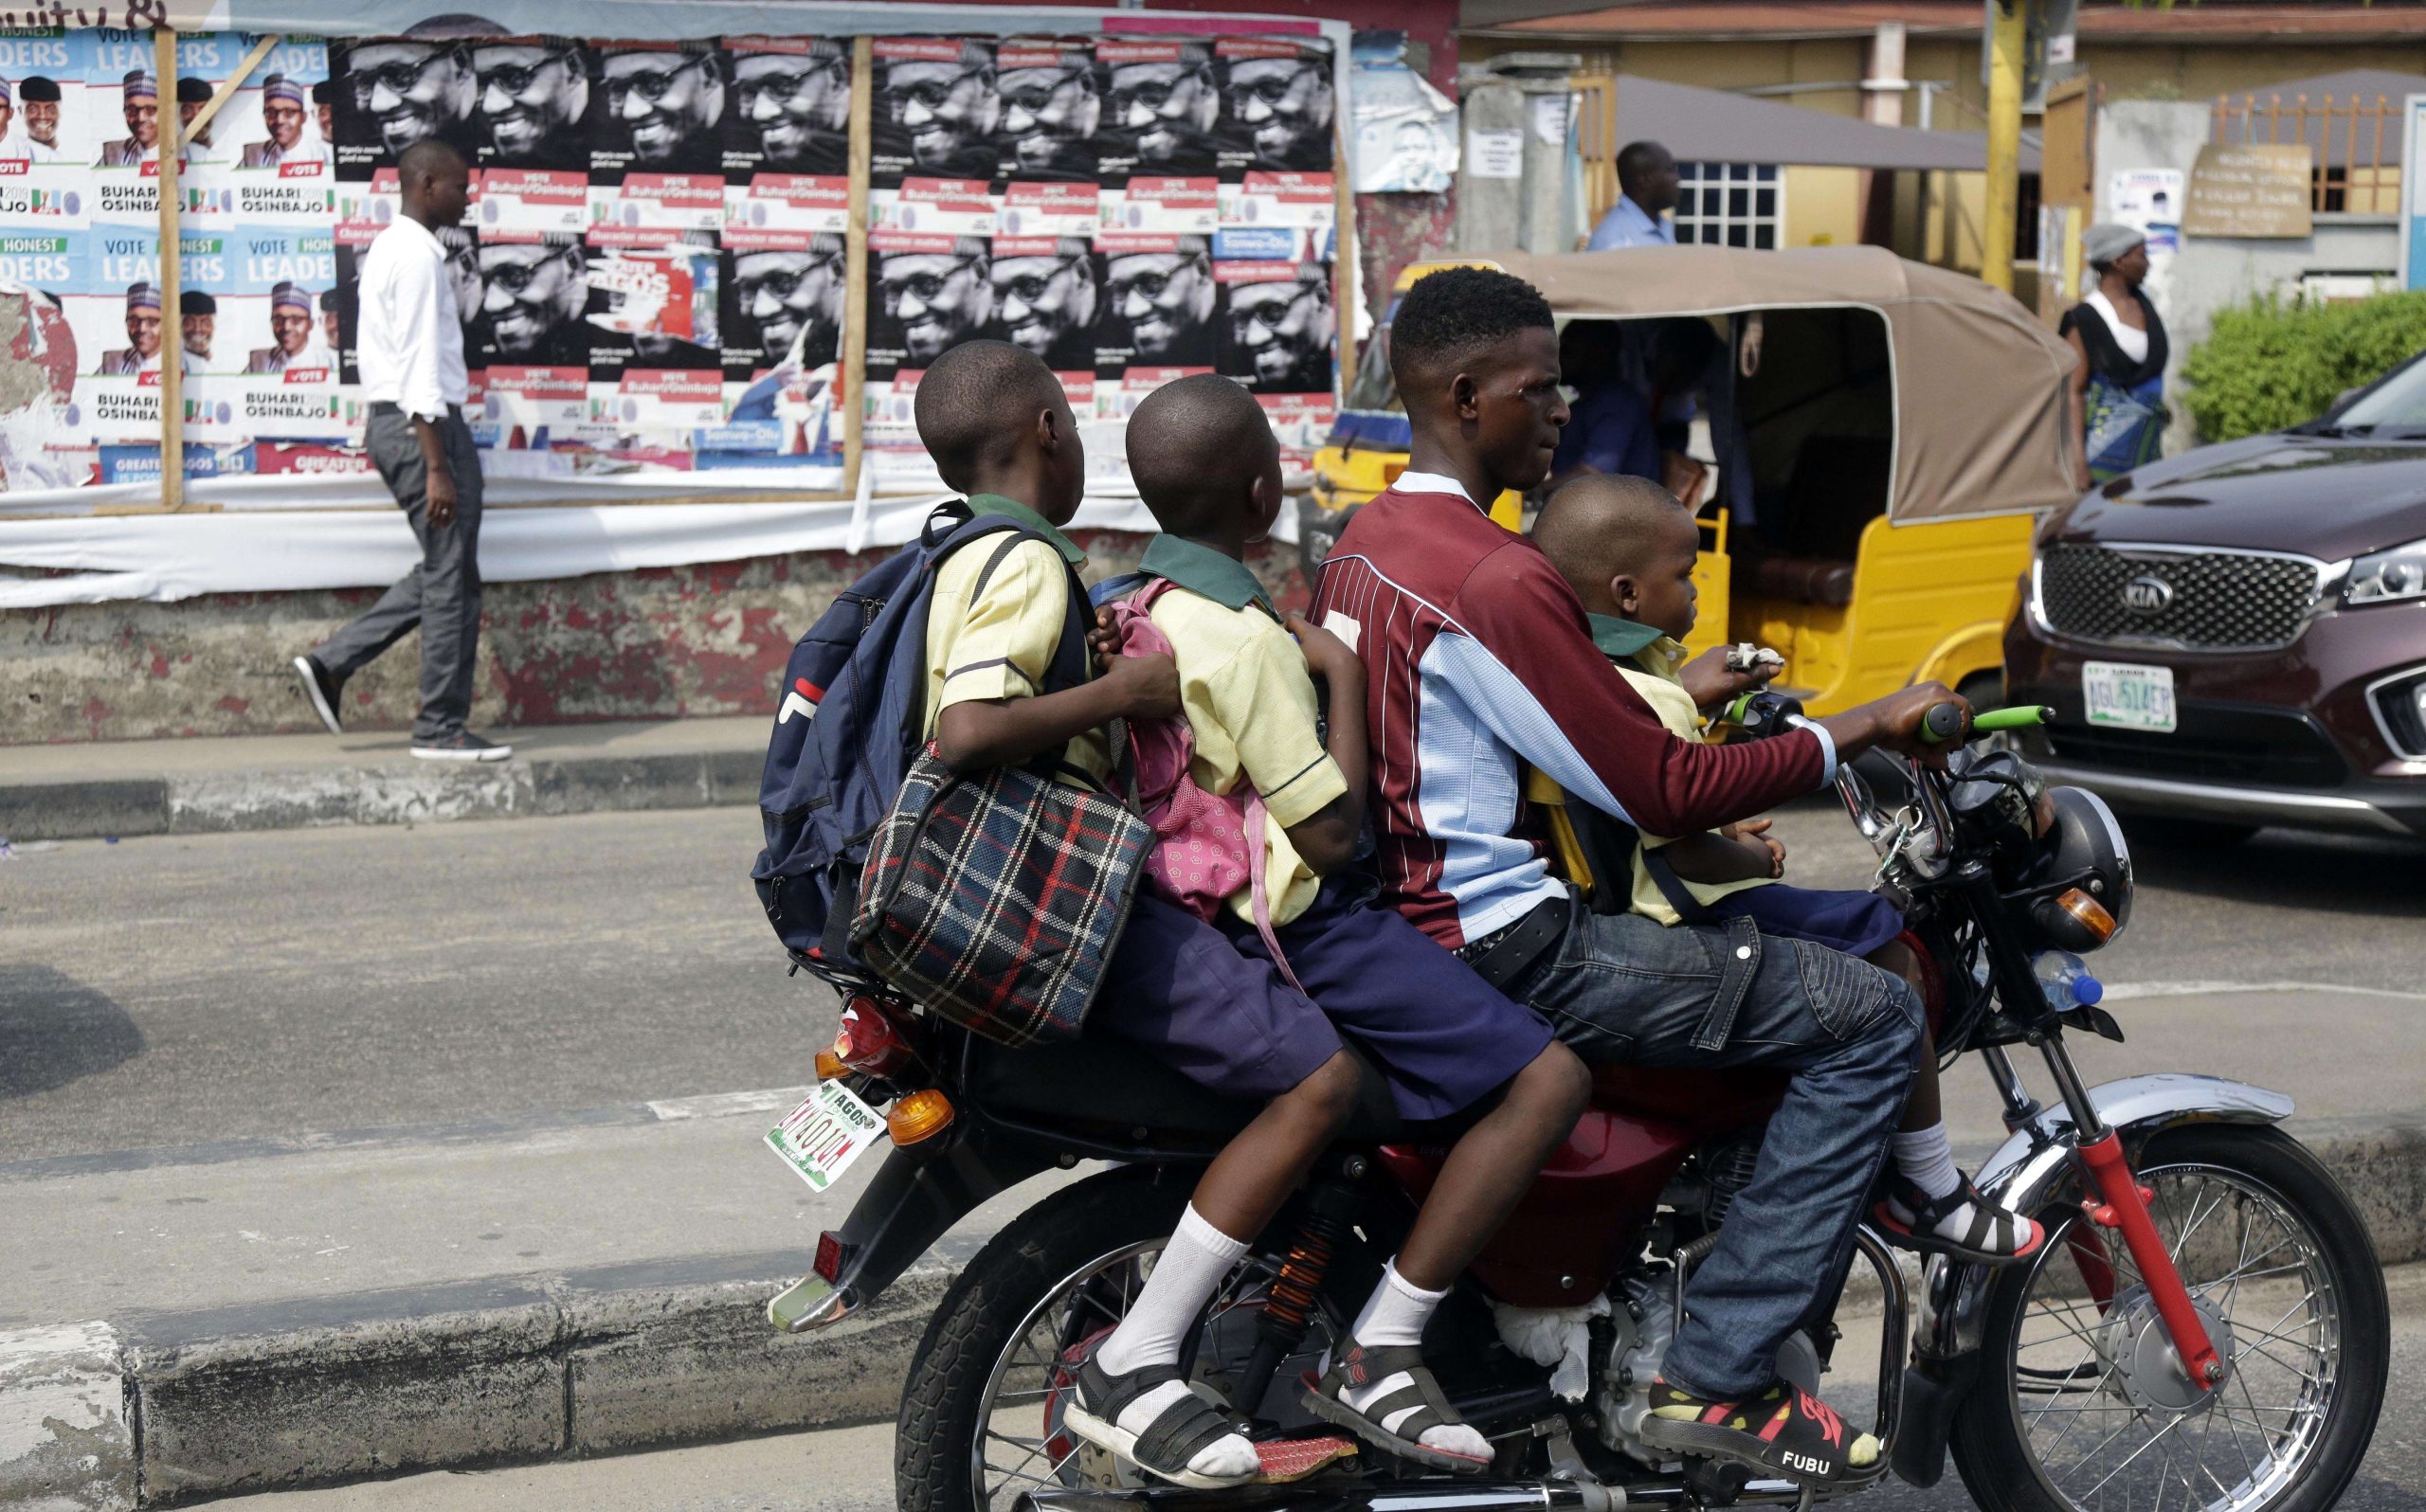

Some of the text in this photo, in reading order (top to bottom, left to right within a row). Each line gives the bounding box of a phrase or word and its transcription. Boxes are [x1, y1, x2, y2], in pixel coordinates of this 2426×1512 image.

[97, 42, 221, 71] LEAERS
[101, 187, 157, 198] BUHAR
[242, 188, 300, 199] BUHARI
[242, 201, 323, 213] OSINBAJO
[4, 239, 58, 253] HONEST
[105, 239, 145, 255] VOTE
[248, 240, 289, 255] VOTE
[247, 257, 335, 283] LEADE
[98, 394, 159, 407] BUHARI
[246, 392, 305, 405] BUHARI
[98, 407, 161, 421] OSINBA
[246, 405, 326, 419] OSINBAJO
[116, 458, 161, 472] GREATE
[2125, 584, 2162, 609] KIA
[834, 1094, 867, 1126] AGOS
[1782, 1450, 1830, 1475] FUBU
